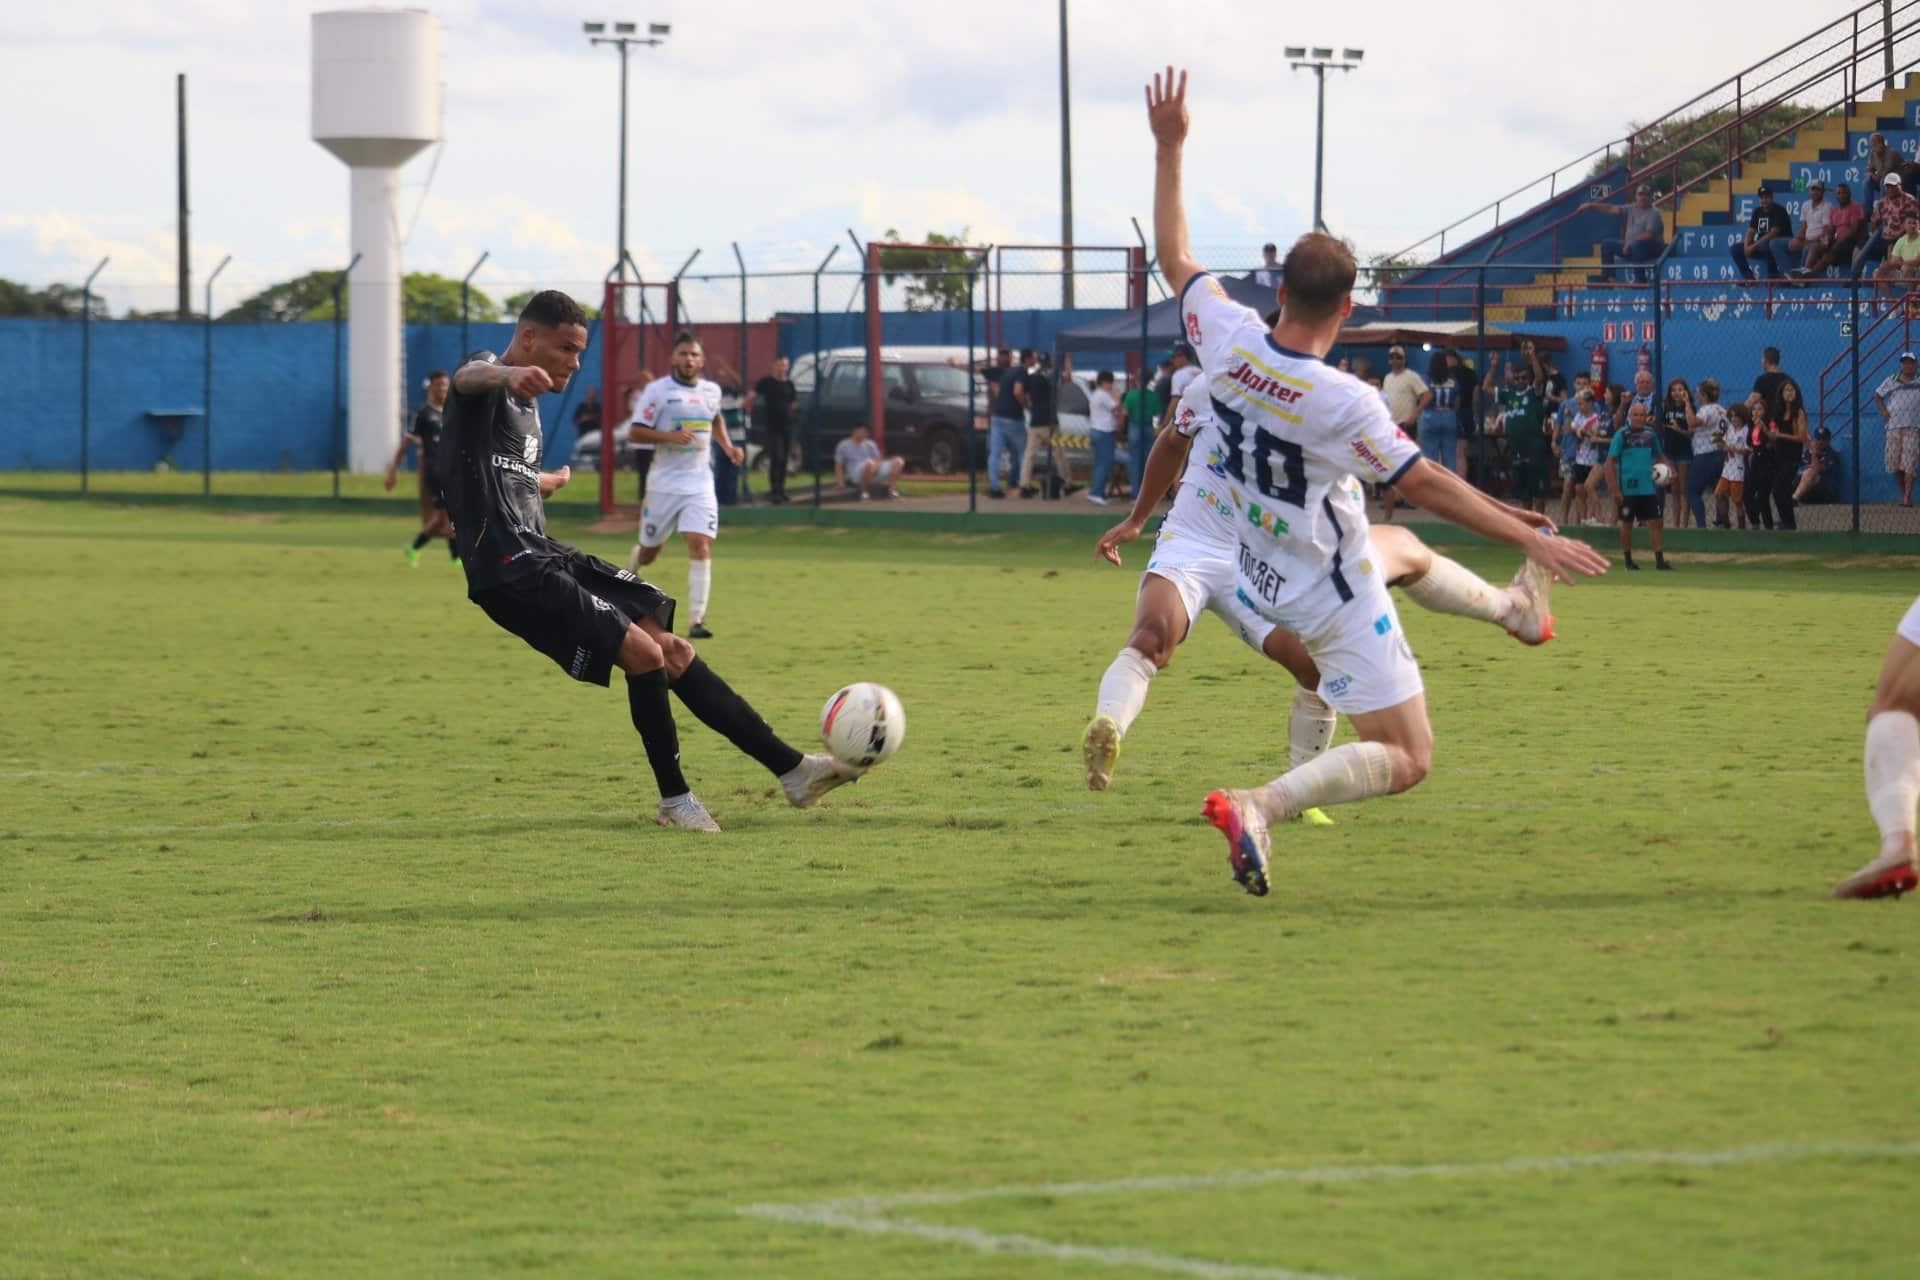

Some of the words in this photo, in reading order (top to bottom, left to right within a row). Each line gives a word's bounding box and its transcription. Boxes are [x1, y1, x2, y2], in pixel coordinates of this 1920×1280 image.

[1857, 137, 1869, 157] C
[1902, 139, 1916, 153] 02
[1801, 168, 1812, 187] D
[1818, 169, 1832, 182] 01
[1786, 201, 1800, 215] 02
[1684, 232, 1695, 253] F
[1700, 234, 1714, 248] 01
[1668, 265, 1682, 280] 02
[1694, 265, 1708, 280] 03
[1720, 265, 1734, 280] 04
[1209, 391, 1308, 509] 10
[1248, 502, 1289, 537] B&F
